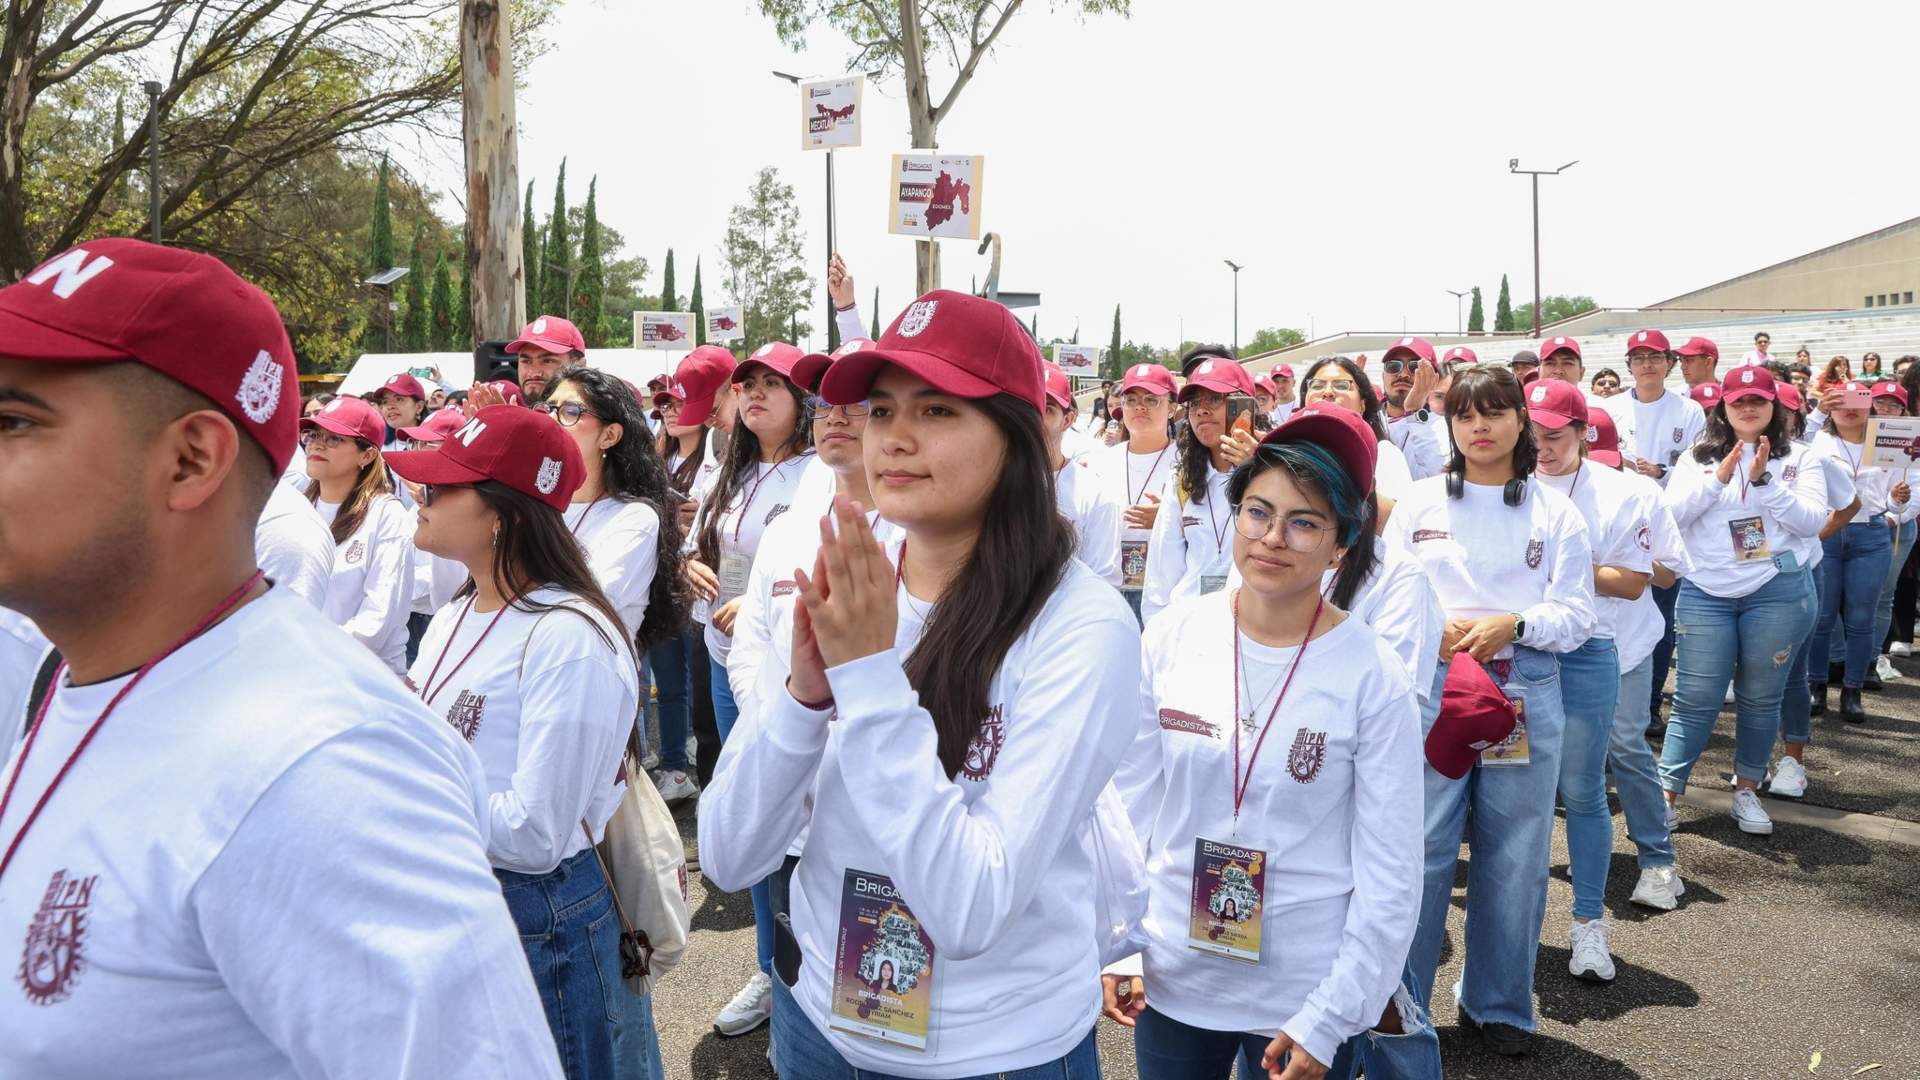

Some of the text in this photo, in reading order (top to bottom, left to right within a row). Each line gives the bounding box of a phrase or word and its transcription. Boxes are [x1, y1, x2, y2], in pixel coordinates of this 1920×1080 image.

[901, 187, 932, 198] AYAPANGO
[462, 694, 487, 708] IPN
[1304, 731, 1327, 746] IPN
[1203, 842, 1258, 861] BRIGADAS
[53, 874, 99, 908] IPN
